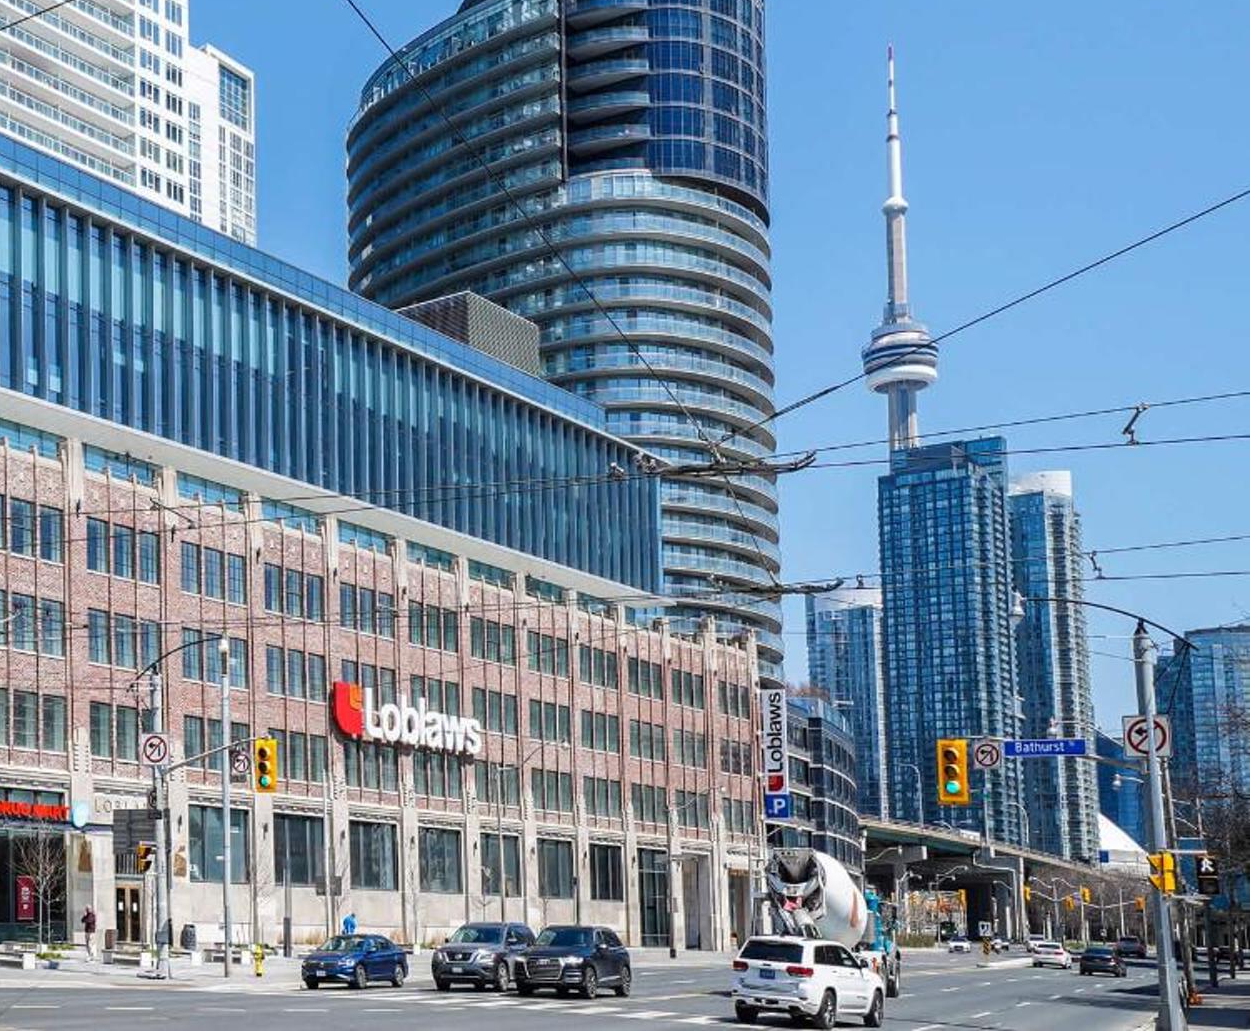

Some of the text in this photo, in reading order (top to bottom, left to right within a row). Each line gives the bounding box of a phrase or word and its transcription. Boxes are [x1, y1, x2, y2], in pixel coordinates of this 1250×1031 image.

[364, 687, 483, 755] Loblaws
[765, 691, 785, 773] Loblaws
[1014, 741, 1065, 753] Bathurst
[772, 798, 786, 815] P
